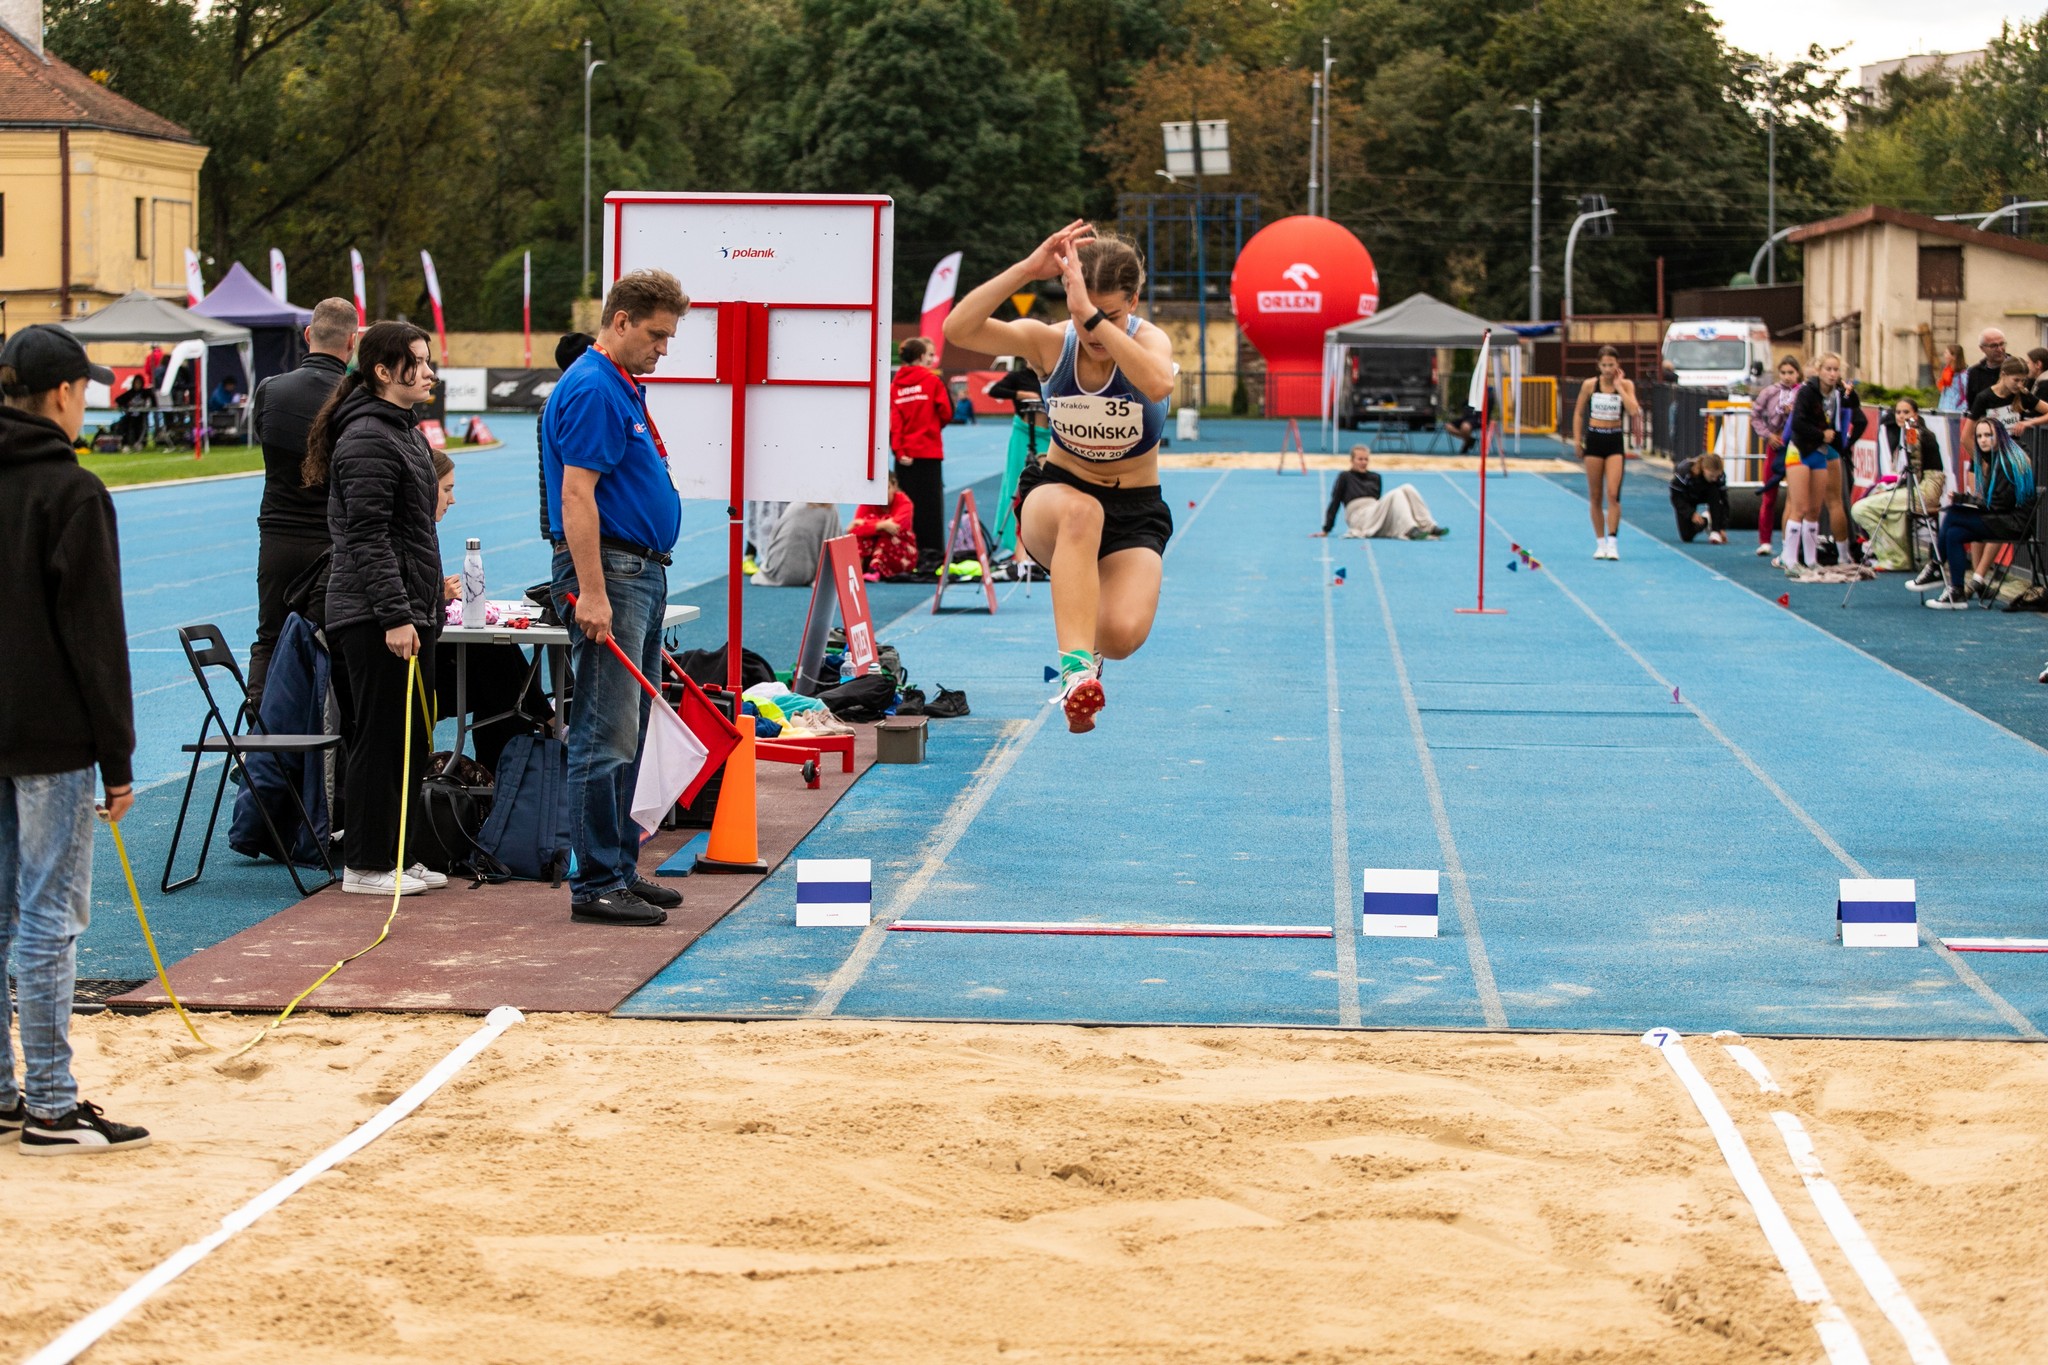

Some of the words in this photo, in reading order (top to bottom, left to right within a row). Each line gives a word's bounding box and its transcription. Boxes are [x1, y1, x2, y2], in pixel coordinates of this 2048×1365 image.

[732, 247, 775, 260] polanik
[1262, 296, 1316, 308] ORLEN
[1060, 402, 1090, 410] Kraków
[1105, 401, 1130, 417] 35
[1053, 420, 1139, 439] CHOIŃSKA
[853, 628, 871, 659] ORLEN
[1653, 1033, 1668, 1047] 7
